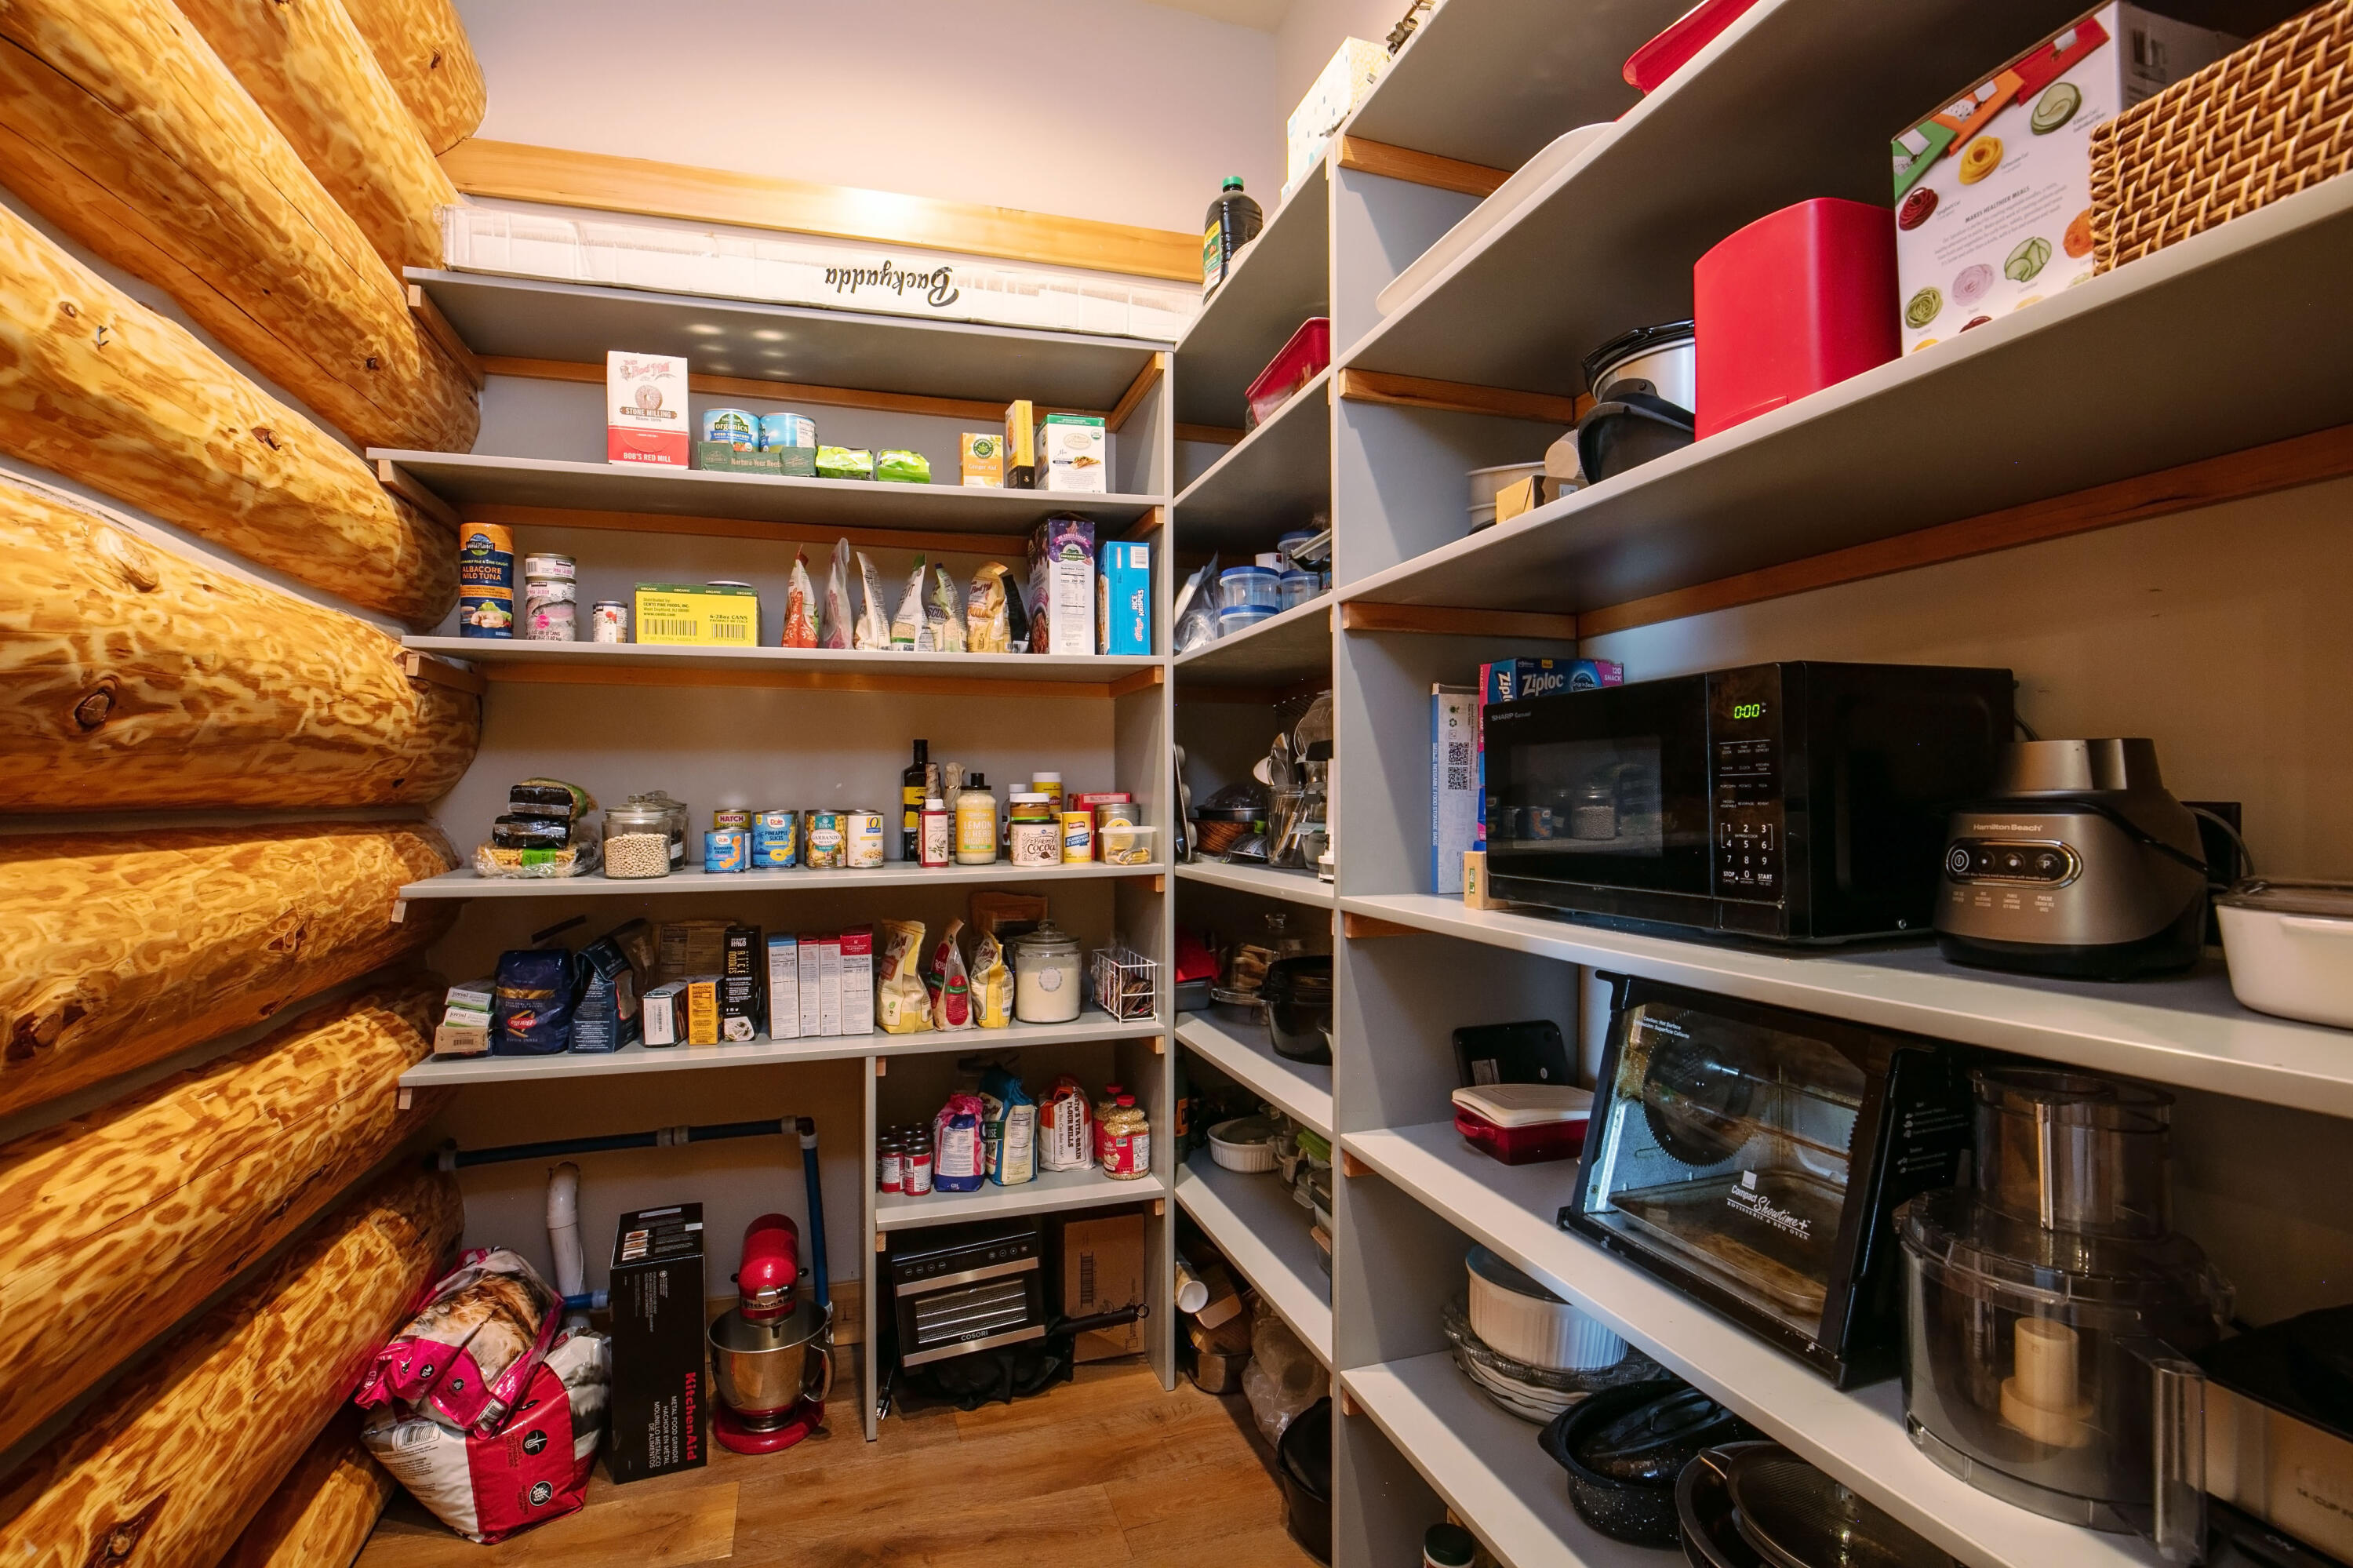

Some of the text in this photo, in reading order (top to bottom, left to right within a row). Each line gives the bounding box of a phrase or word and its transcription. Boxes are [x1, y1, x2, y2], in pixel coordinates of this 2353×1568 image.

[1965, 186, 2030, 223] MAKES HEALTHIER MEALS
[824, 260, 959, 307] Backyadda
[625, 407, 671, 418] STONE MILLING
[731, 457, 752, 466] Nurture
[753, 458, 766, 467] Your
[462, 565, 503, 575] ALBACORE
[478, 573, 502, 581] TUNA
[1522, 671, 1564, 697] Ziploc
[1734, 704, 1760, 719] 0:00
[1492, 712, 1514, 721] SHARP
[963, 820, 992, 829] LEMON
[1727, 824, 1731, 832] 1
[1744, 824, 1748, 832] 2
[1761, 824, 1766, 833] 3
[1027, 843, 1056, 855] Cocoa
[1726, 854, 1732, 863] 7
[1744, 856, 1749, 864] 8
[1762, 857, 1767, 865] 9
[2043, 860, 2050, 869] P
[1744, 870, 1750, 879] 0
[728, 951, 737, 974] NOODLES
[736, 951, 746, 973] RICE
[1731, 1184, 1758, 1203] Compact
[1727, 1200, 1764, 1221] ROTISSERIE
[1773, 1221, 1787, 1231] BBQ
[1789, 1229, 1808, 1240] OVEN
[961, 1330, 989, 1341] COSORI
[685, 1372, 697, 1461] KitchenAid
[649, 1423, 655, 1432] DE
[663, 1435, 670, 1444] EN
